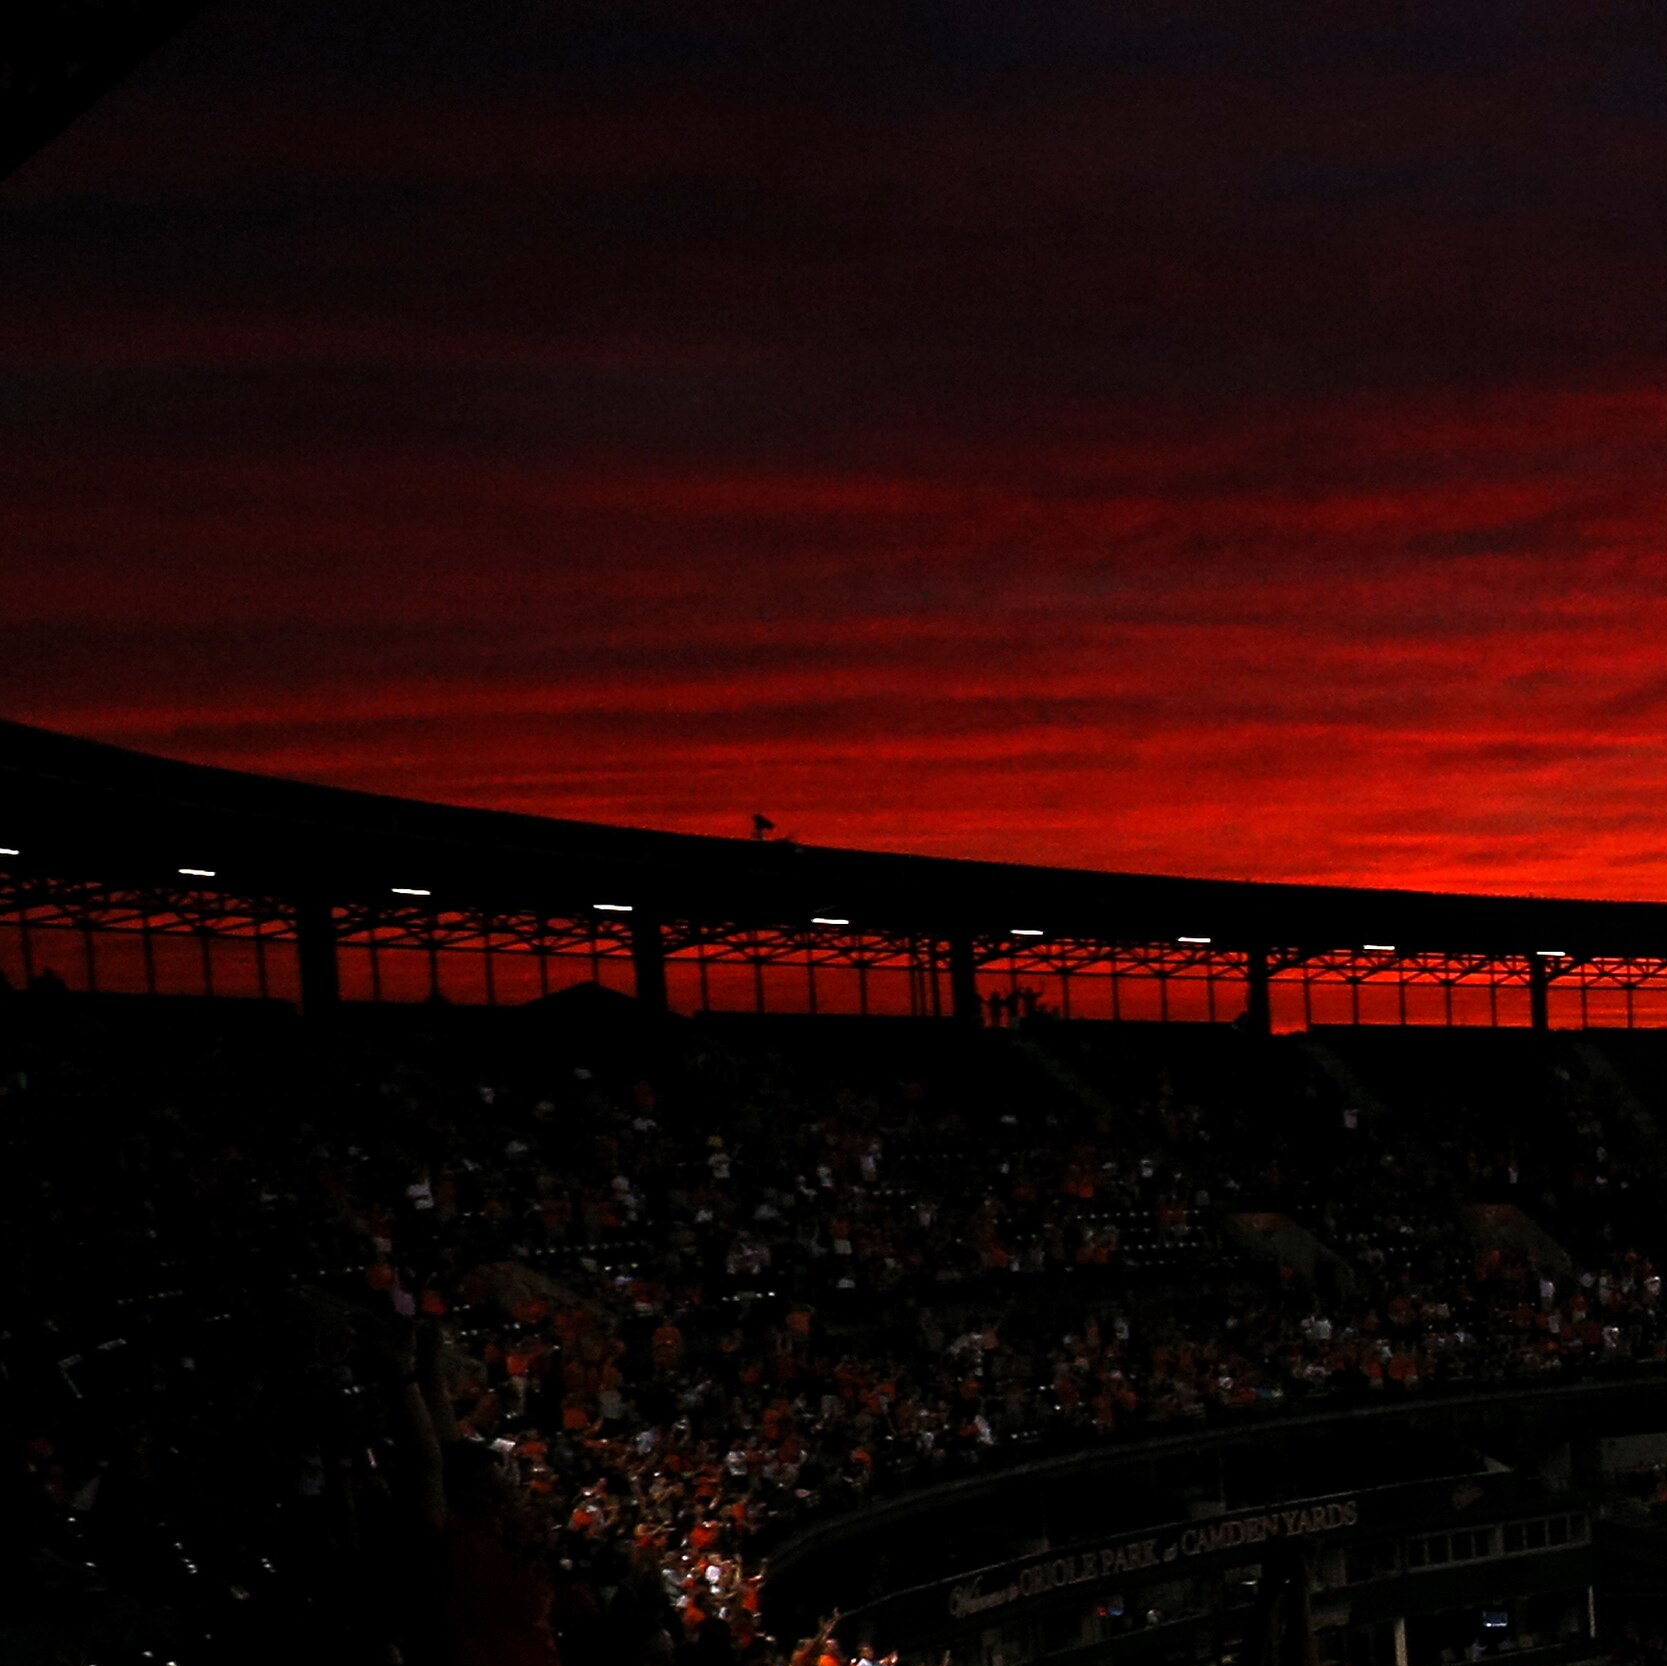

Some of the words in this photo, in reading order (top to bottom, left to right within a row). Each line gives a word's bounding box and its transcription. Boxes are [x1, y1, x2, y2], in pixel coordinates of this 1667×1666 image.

[1100, 1537, 1162, 1575] PARK
[1179, 1514, 1277, 1556] CAMDEN
[1277, 1500, 1359, 1537] YARDS
